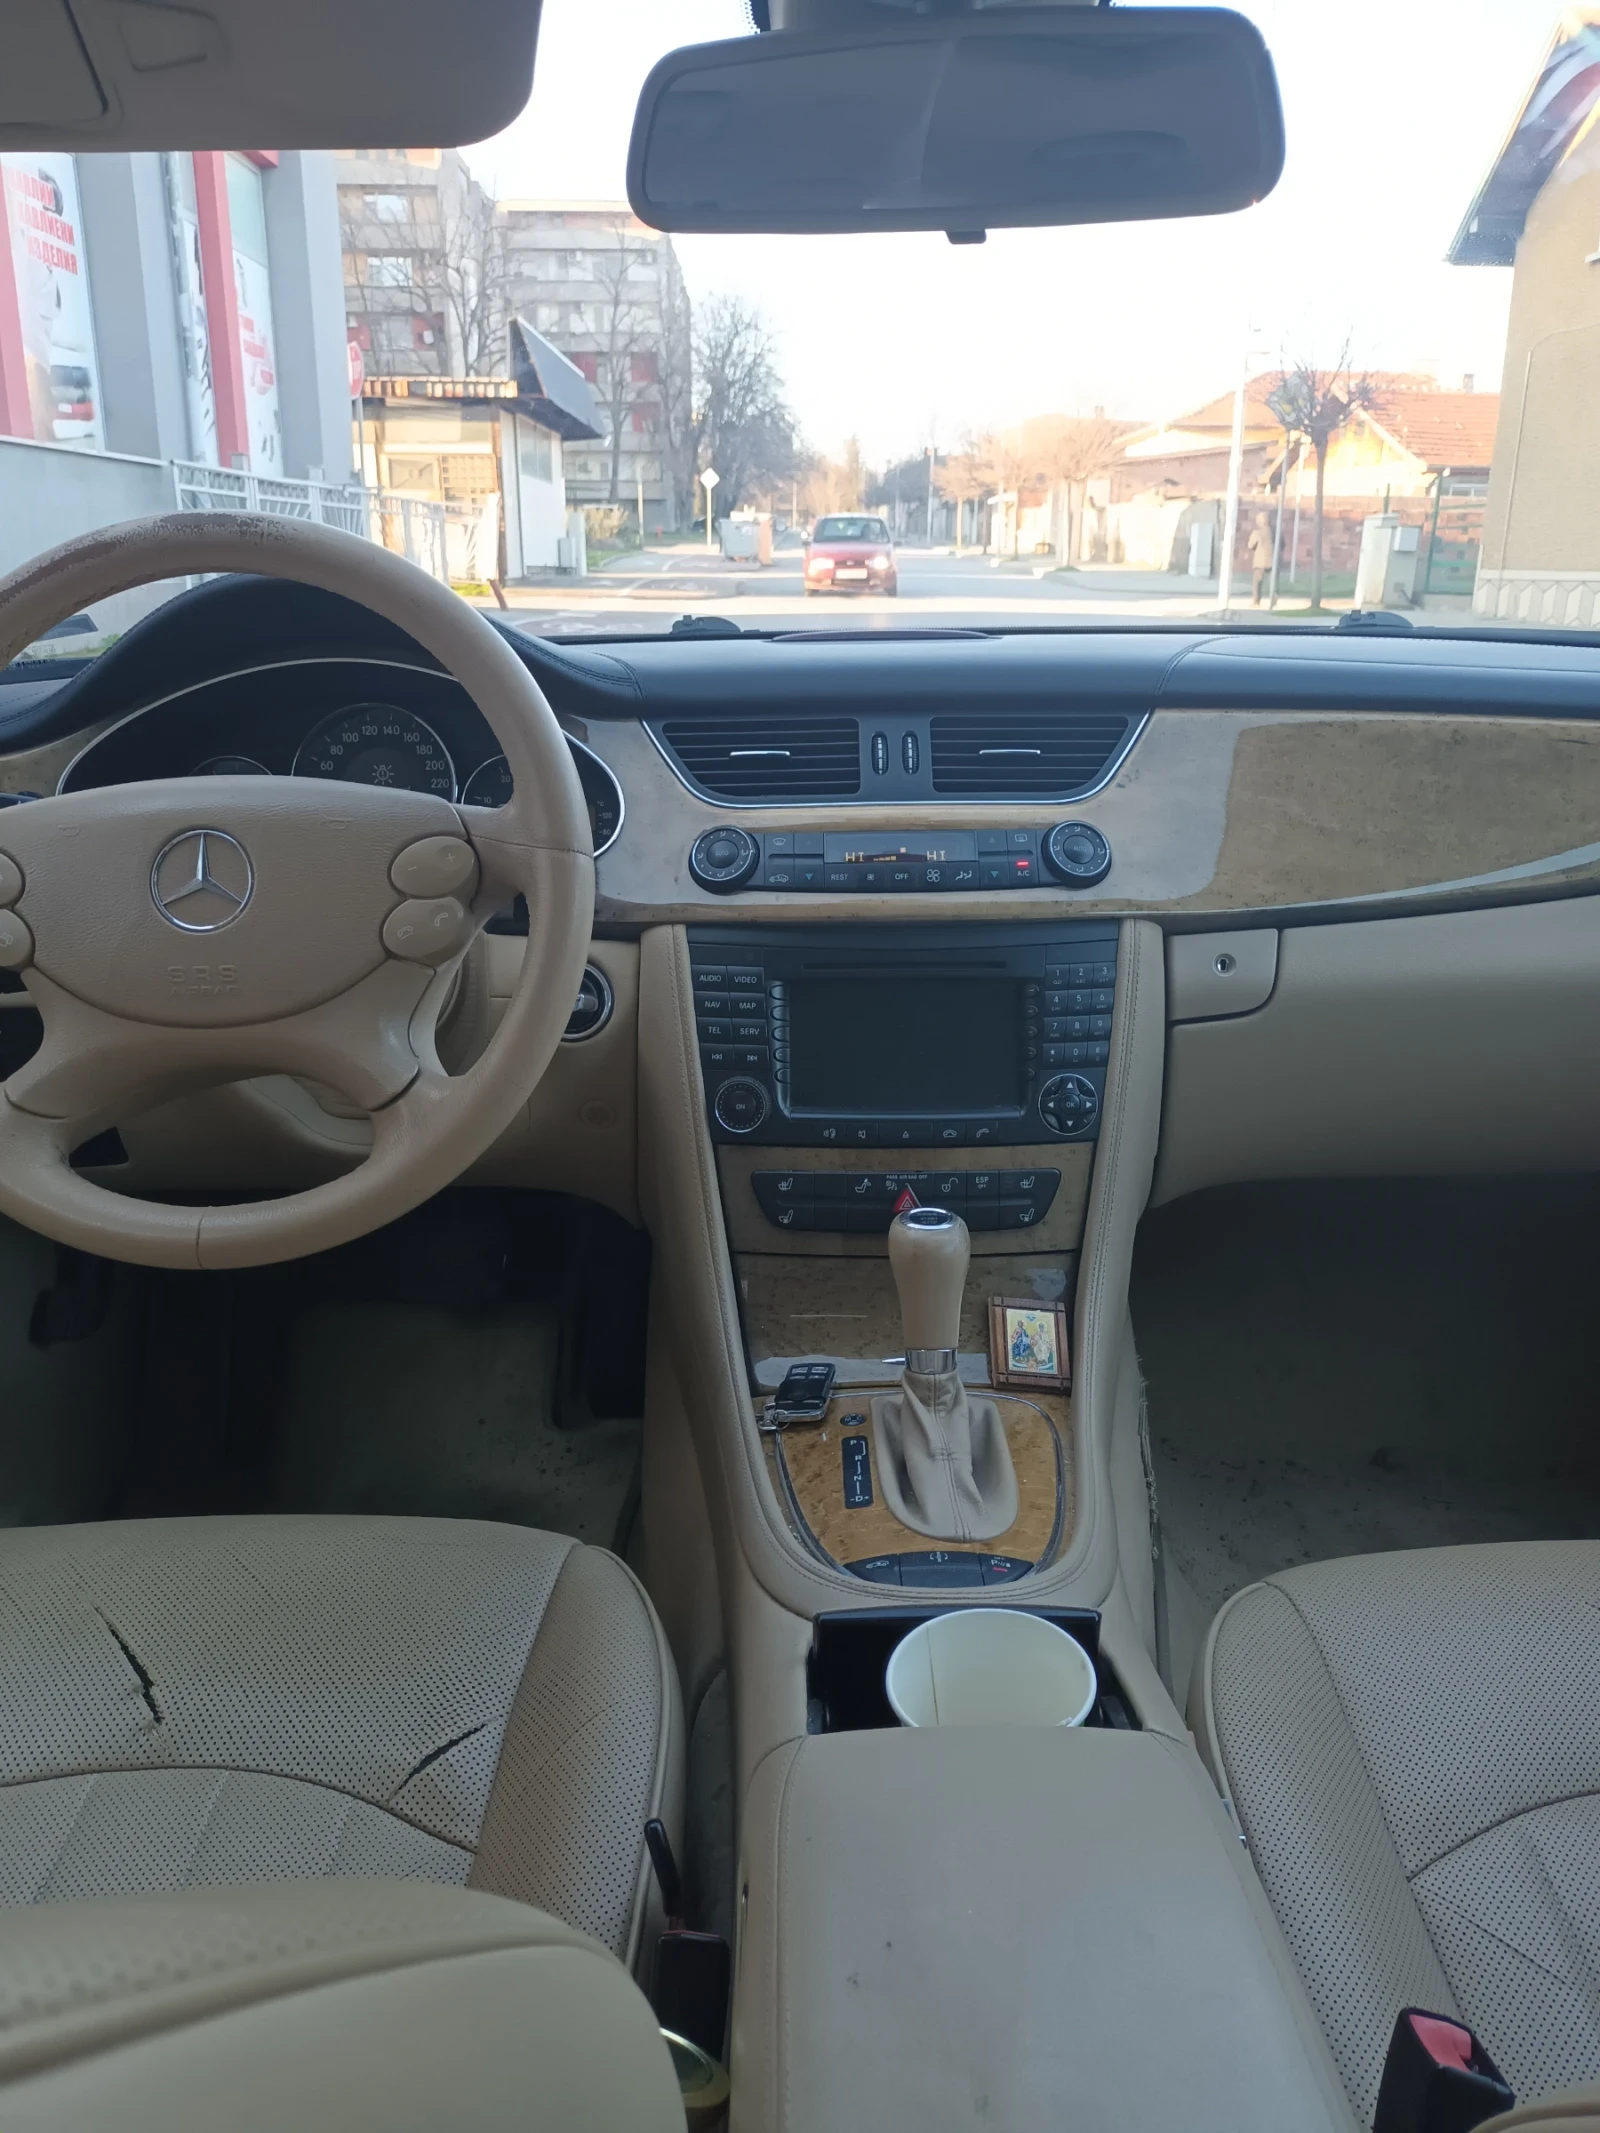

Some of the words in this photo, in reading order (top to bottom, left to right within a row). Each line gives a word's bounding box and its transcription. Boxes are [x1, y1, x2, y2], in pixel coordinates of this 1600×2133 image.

[361, 725, 378, 736] 120
[383, 725, 400, 735] 140
[342, 733, 359, 743] 100
[403, 733, 420, 743] 160
[330, 745, 343, 755] 80
[416, 745, 433, 755] 180
[320, 760, 334, 771] 60
[425, 760, 445, 771] 200
[431, 779, 450, 789] 220
[845, 852, 865, 862] HI
[926, 850, 946, 860] HI
[830, 873, 849, 881] REST
[168, 965, 237, 983] SRS
[734, 976, 758, 984] VIDEO
[704, 1000, 721, 1008] NAV
[708, 1026, 721, 1034] TEL
[975, 1176, 989, 1184] ESP
